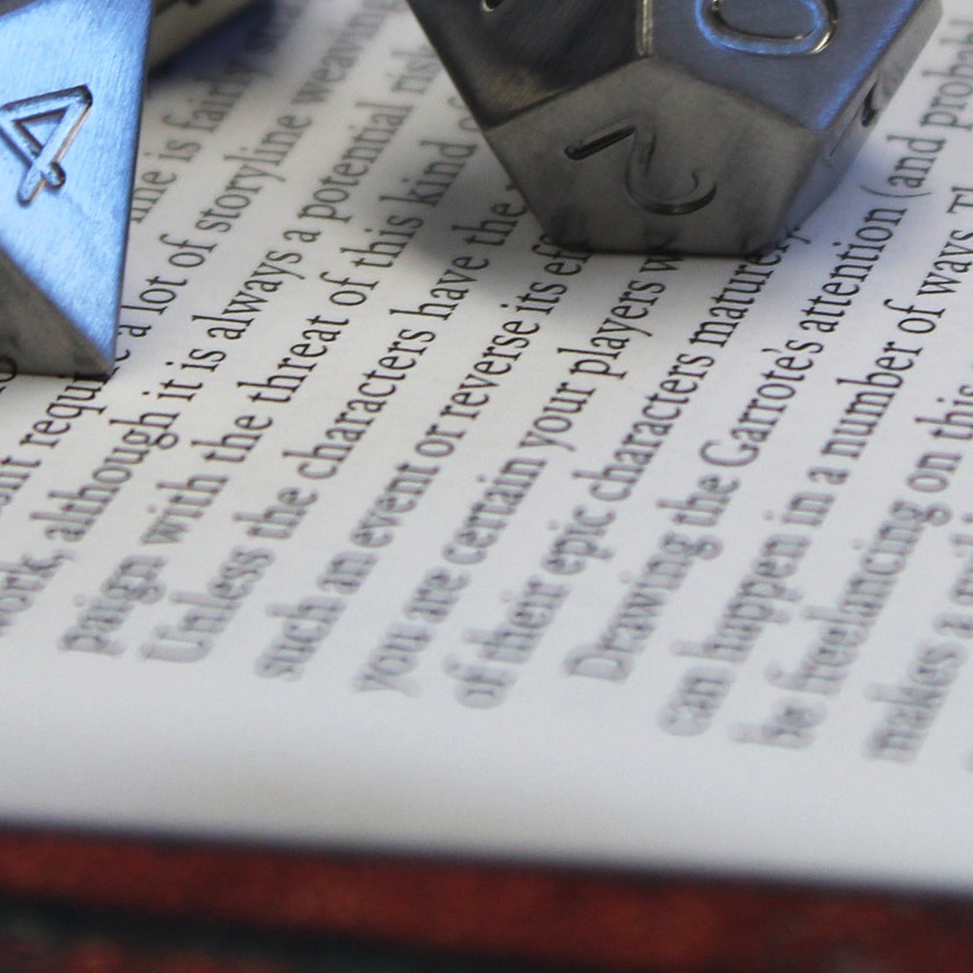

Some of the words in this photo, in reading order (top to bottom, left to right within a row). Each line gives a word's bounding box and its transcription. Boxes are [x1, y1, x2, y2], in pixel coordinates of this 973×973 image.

[142, 140, 201, 163] is
[296, 101, 415, 224] potential
[378, 139, 479, 208] kind
[564, 117, 719, 217] 2
[119, 275, 189, 315] lot
[159, 233, 218, 268] of
[194, 113, 314, 233] storyline
[283, 228, 322, 244] a
[339, 214, 425, 268] this
[190, 248, 306, 341] always
[319, 271, 381, 307] of
[497, 281, 568, 316] its
[883, 298, 946, 335] of
[164, 346, 228, 375] is
[235, 313, 351, 405] threat
[555, 279, 667, 380] players
[141, 379, 204, 402] it
[439, 319, 541, 420] reverse
[820, 340, 924, 460] number
[139, 544, 277, 664] Unless
[232, 485, 321, 541] the
[281, 325, 438, 481] characters
[389, 252, 492, 322] have
[449, 201, 528, 247] the
[190, 413, 274, 464] the
[413, 422, 468, 459] or
[518, 381, 597, 452] your
[560, 529, 726, 683] Drawing
[655, 477, 741, 530] the
[799, 208, 908, 334] attention
[859, 134, 947, 198] (and
[570, 352, 717, 503] characters
[30, 410, 181, 543] although
[139, 473, 231, 546] with
[348, 463, 442, 550] event
[440, 459, 548, 566] certain
[760, 490, 837, 528] in
[806, 467, 851, 486] a
[315, 550, 380, 596] an
[539, 505, 619, 576] epic
[762, 497, 954, 697] freelancing
[906, 450, 962, 494] on
[401, 566, 472, 625] are
[461, 576, 573, 664] their
[668, 533, 814, 664] happen
[349, 624, 437, 699] you
